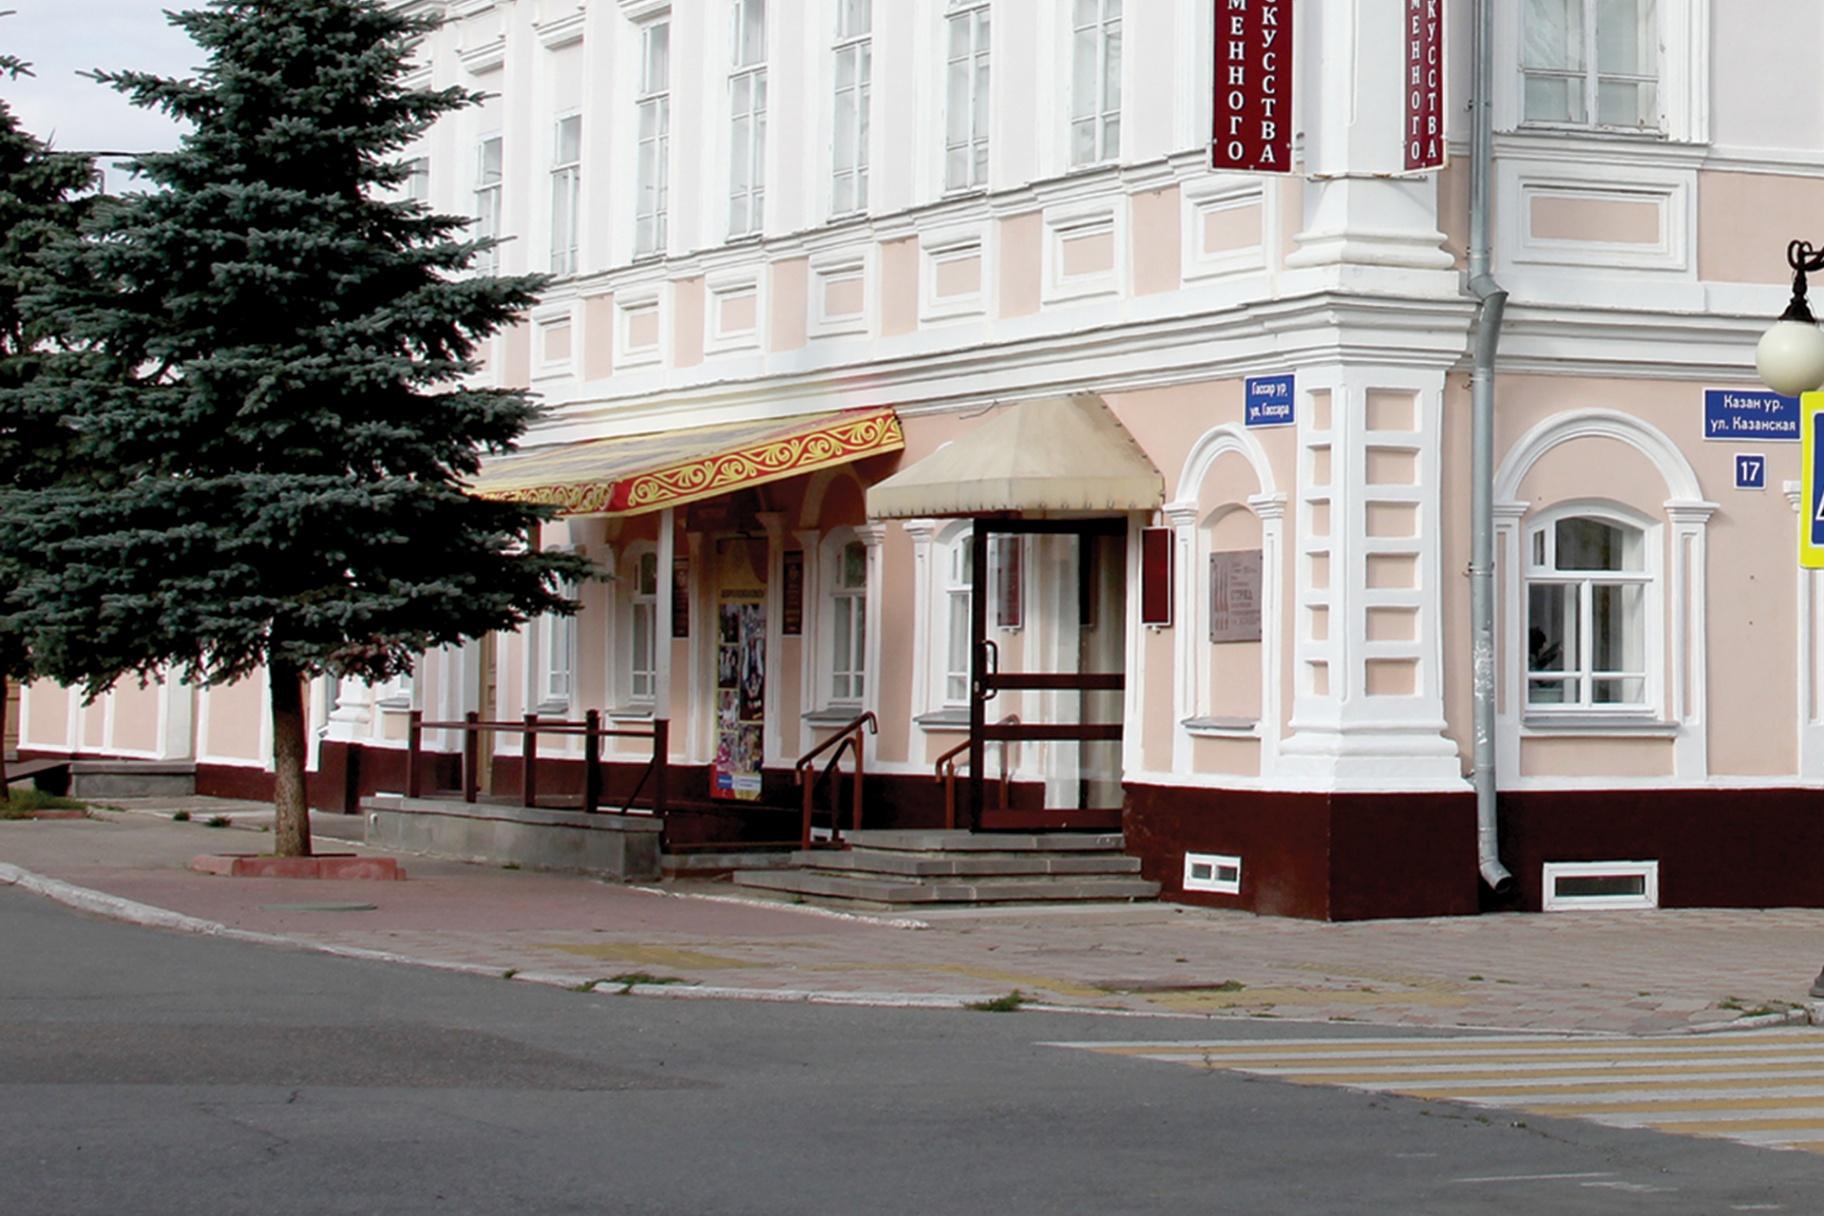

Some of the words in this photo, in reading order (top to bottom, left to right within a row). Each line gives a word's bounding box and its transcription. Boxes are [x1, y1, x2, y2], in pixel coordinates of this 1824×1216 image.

[1724, 394, 1761, 409] Казан
[1763, 398, 1784, 413] ур.
[1711, 417, 1730, 432] ул.
[1732, 416, 1796, 432] Казанская
[1741, 462, 1760, 482] 17
